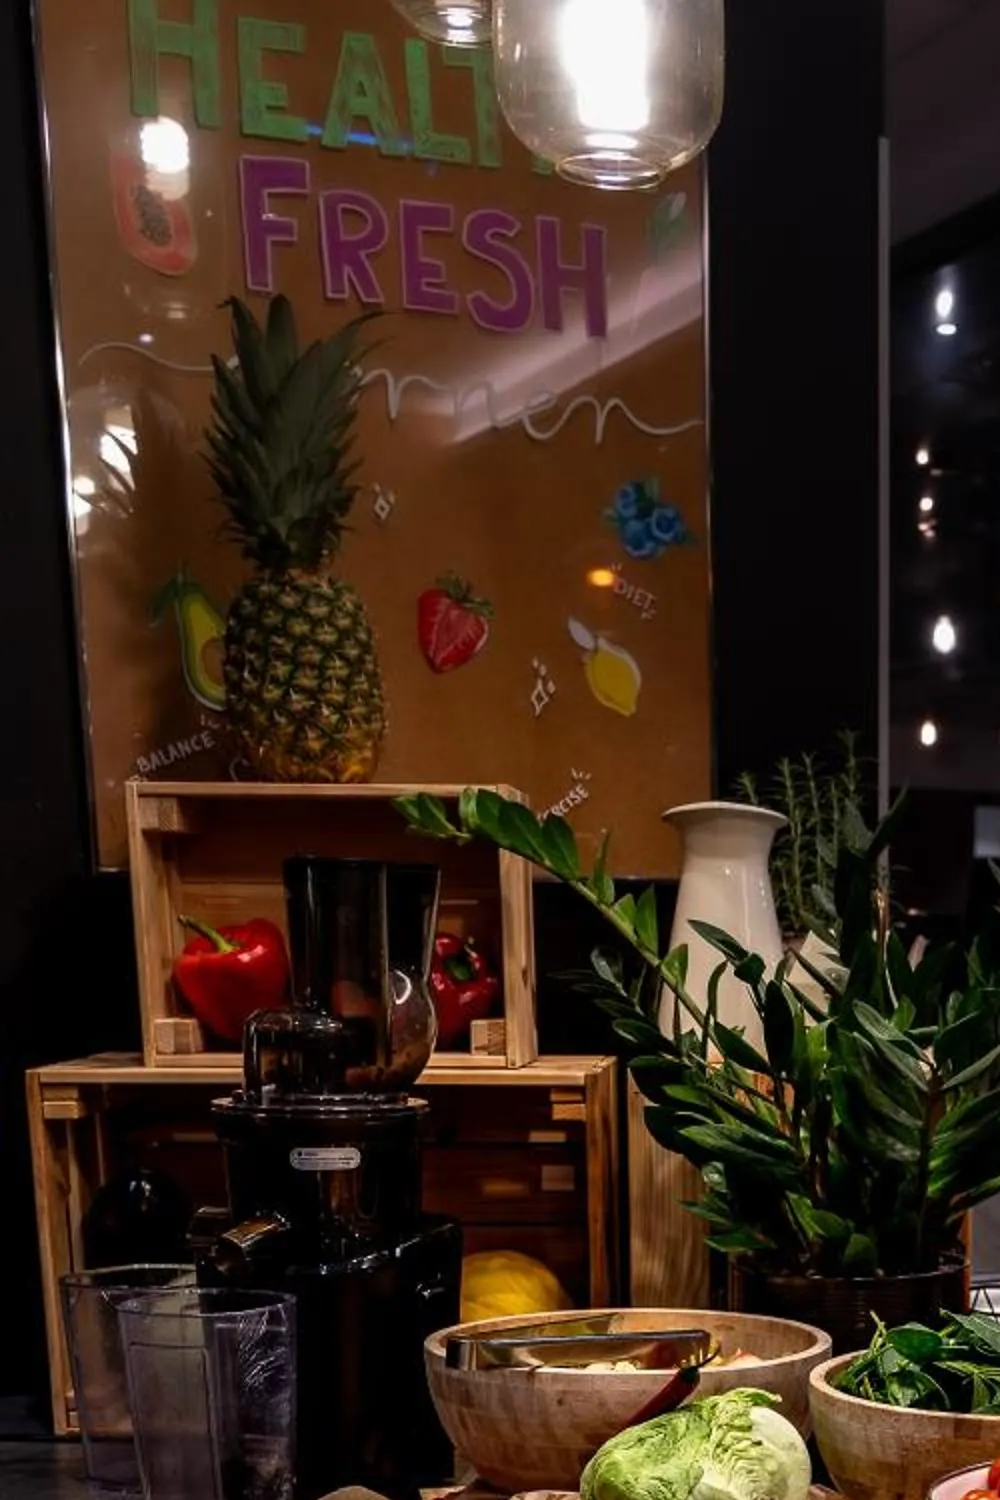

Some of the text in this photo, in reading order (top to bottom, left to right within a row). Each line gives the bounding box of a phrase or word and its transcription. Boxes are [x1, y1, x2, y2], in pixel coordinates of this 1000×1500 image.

[127, 0, 556, 176] HEALT
[238, 154, 608, 338] FRESH
[613, 576, 658, 609] DIET
[136, 730, 216, 773] BALANCE
